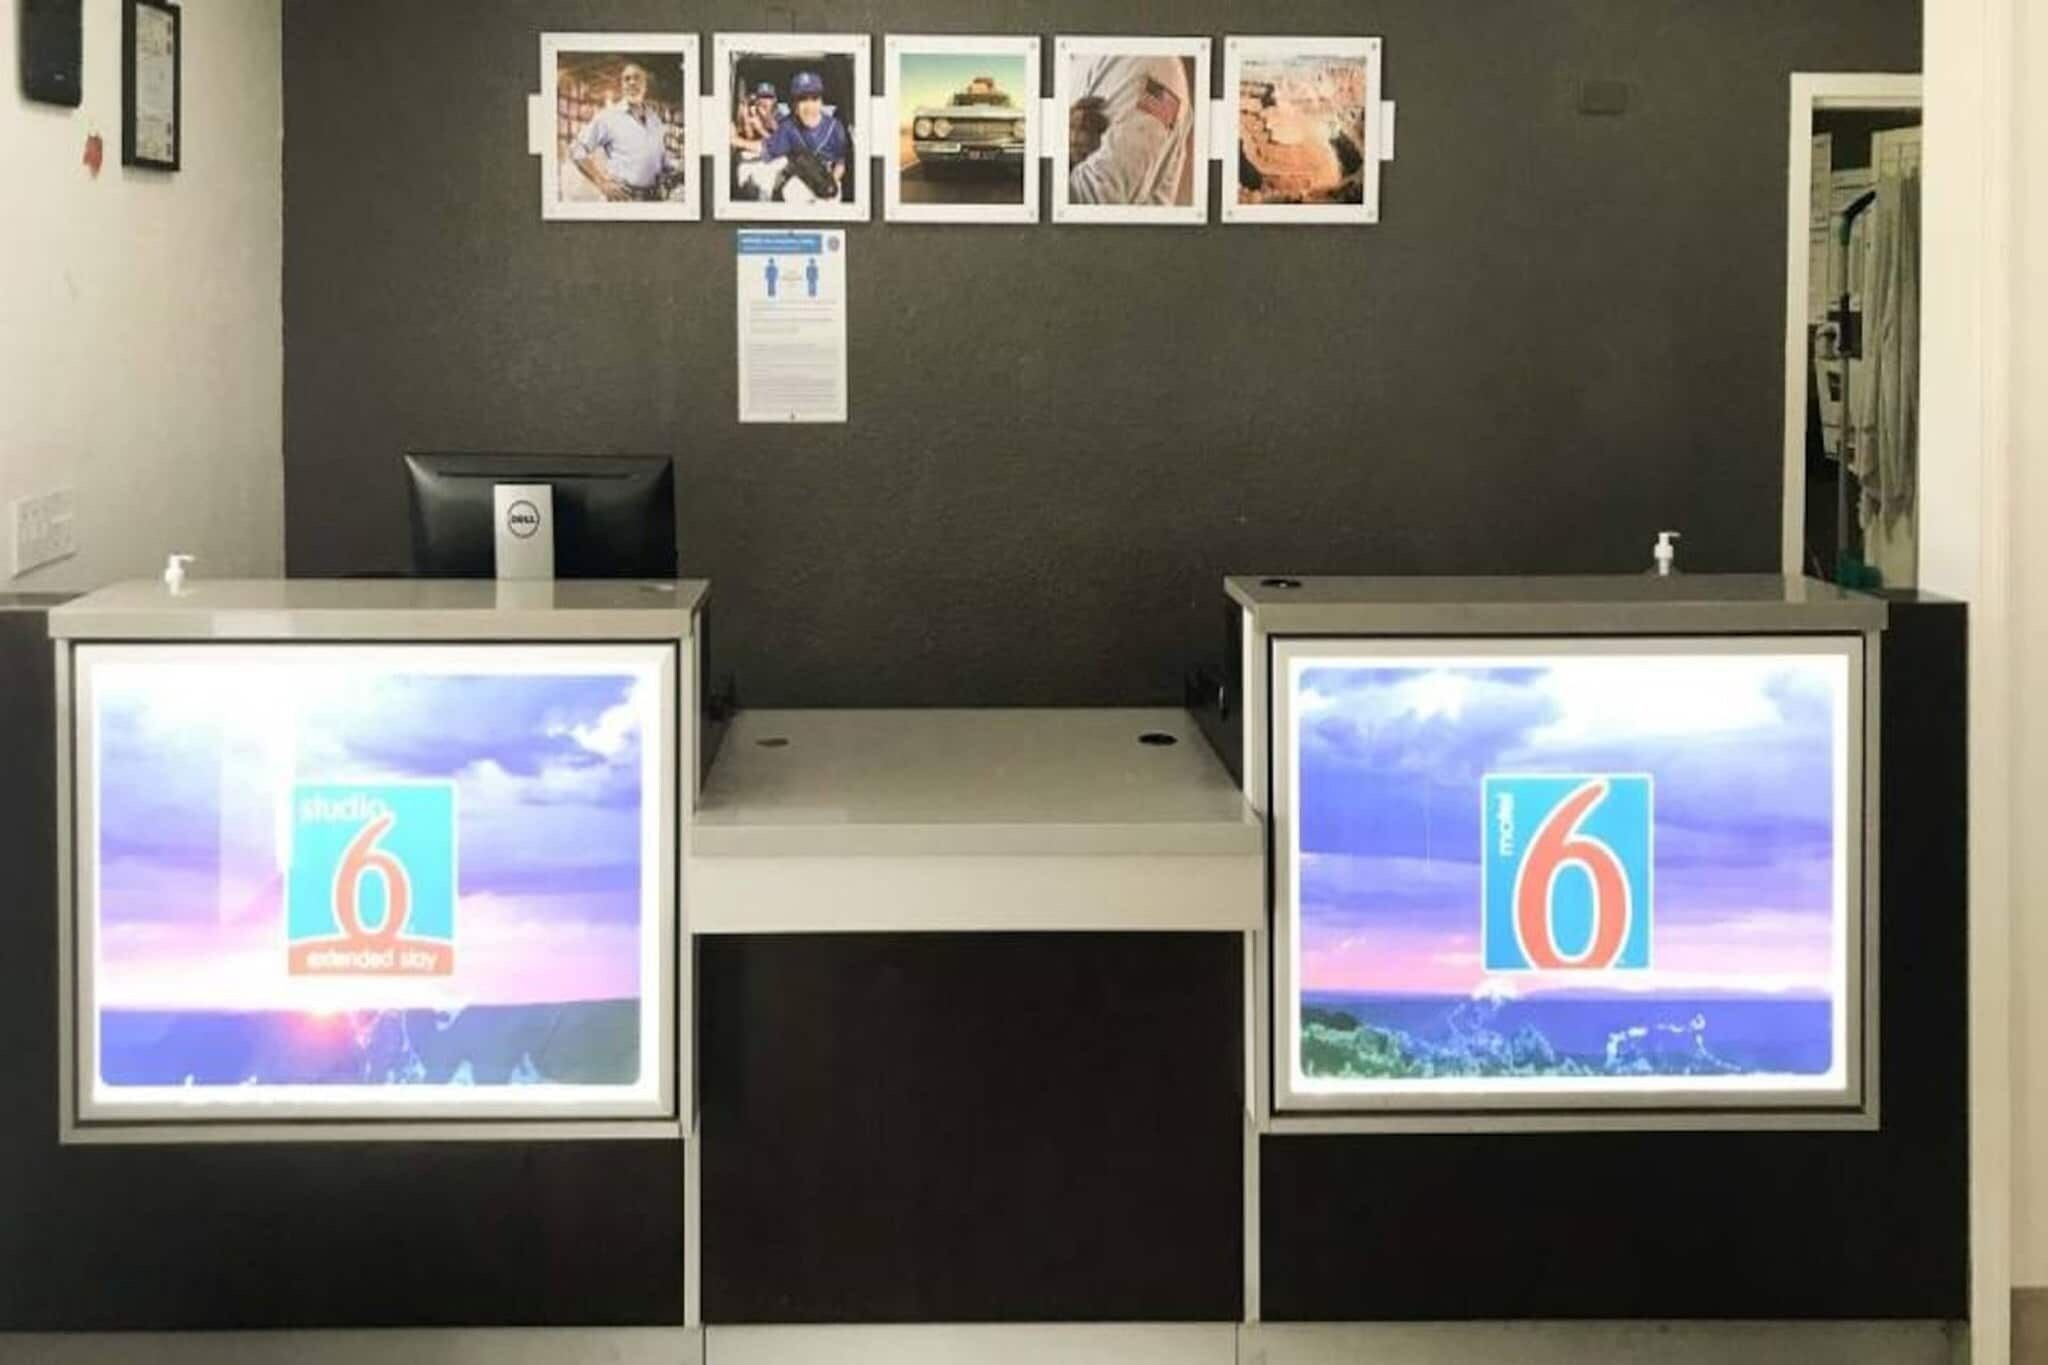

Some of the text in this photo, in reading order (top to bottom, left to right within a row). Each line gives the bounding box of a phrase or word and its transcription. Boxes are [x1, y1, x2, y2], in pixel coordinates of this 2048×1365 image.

[301, 794, 387, 823] studio
[1498, 792, 1514, 857] motel
[332, 811, 411, 938] 6
[1513, 774, 1632, 971] 6
[306, 948, 438, 972] extended stay
